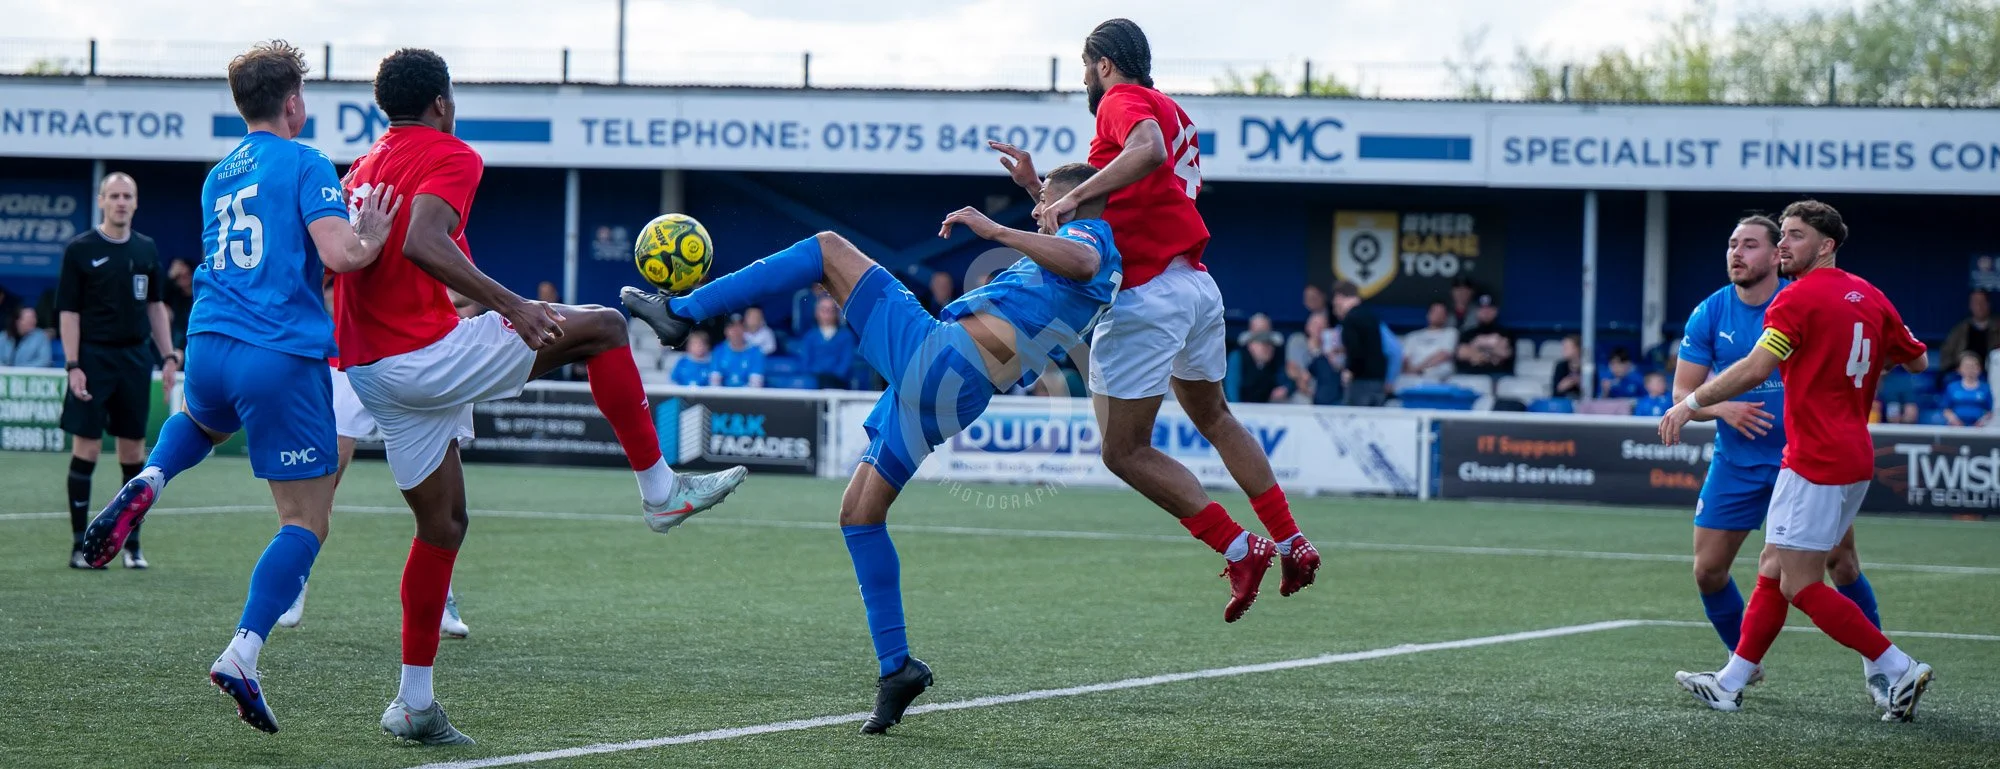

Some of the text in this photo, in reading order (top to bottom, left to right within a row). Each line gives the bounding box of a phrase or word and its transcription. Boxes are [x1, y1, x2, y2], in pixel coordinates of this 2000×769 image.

[338, 103, 390, 143] DM
[580, 118, 1076, 154] TELEPHONE: 01375 845070
[1241, 116, 1344, 162] DMC
[225, 157, 254, 170] CROWN
[1503, 137, 1720, 168] SPECIALIST
[1740, 139, 1915, 170] FINISHES
[217, 162, 258, 180] BILLERICAY
[0, 194, 77, 215] ORLD
[321, 187, 345, 203] DM
[213, 183, 263, 270] 15
[1402, 234, 1479, 256] GAME
[1401, 253, 1460, 277] TOO
[1846, 322, 1871, 388] 4
[0, 400, 63, 422] OMPANY
[710, 434, 811, 458] FACADES
[1151, 421, 1287, 458] awy
[1477, 435, 1576, 458] IT Support
[280, 447, 317, 466] DMC
[1621, 439, 1701, 465] Security
[1458, 461, 1595, 485] Cloud Services
[1907, 488, 1924, 506] IT
